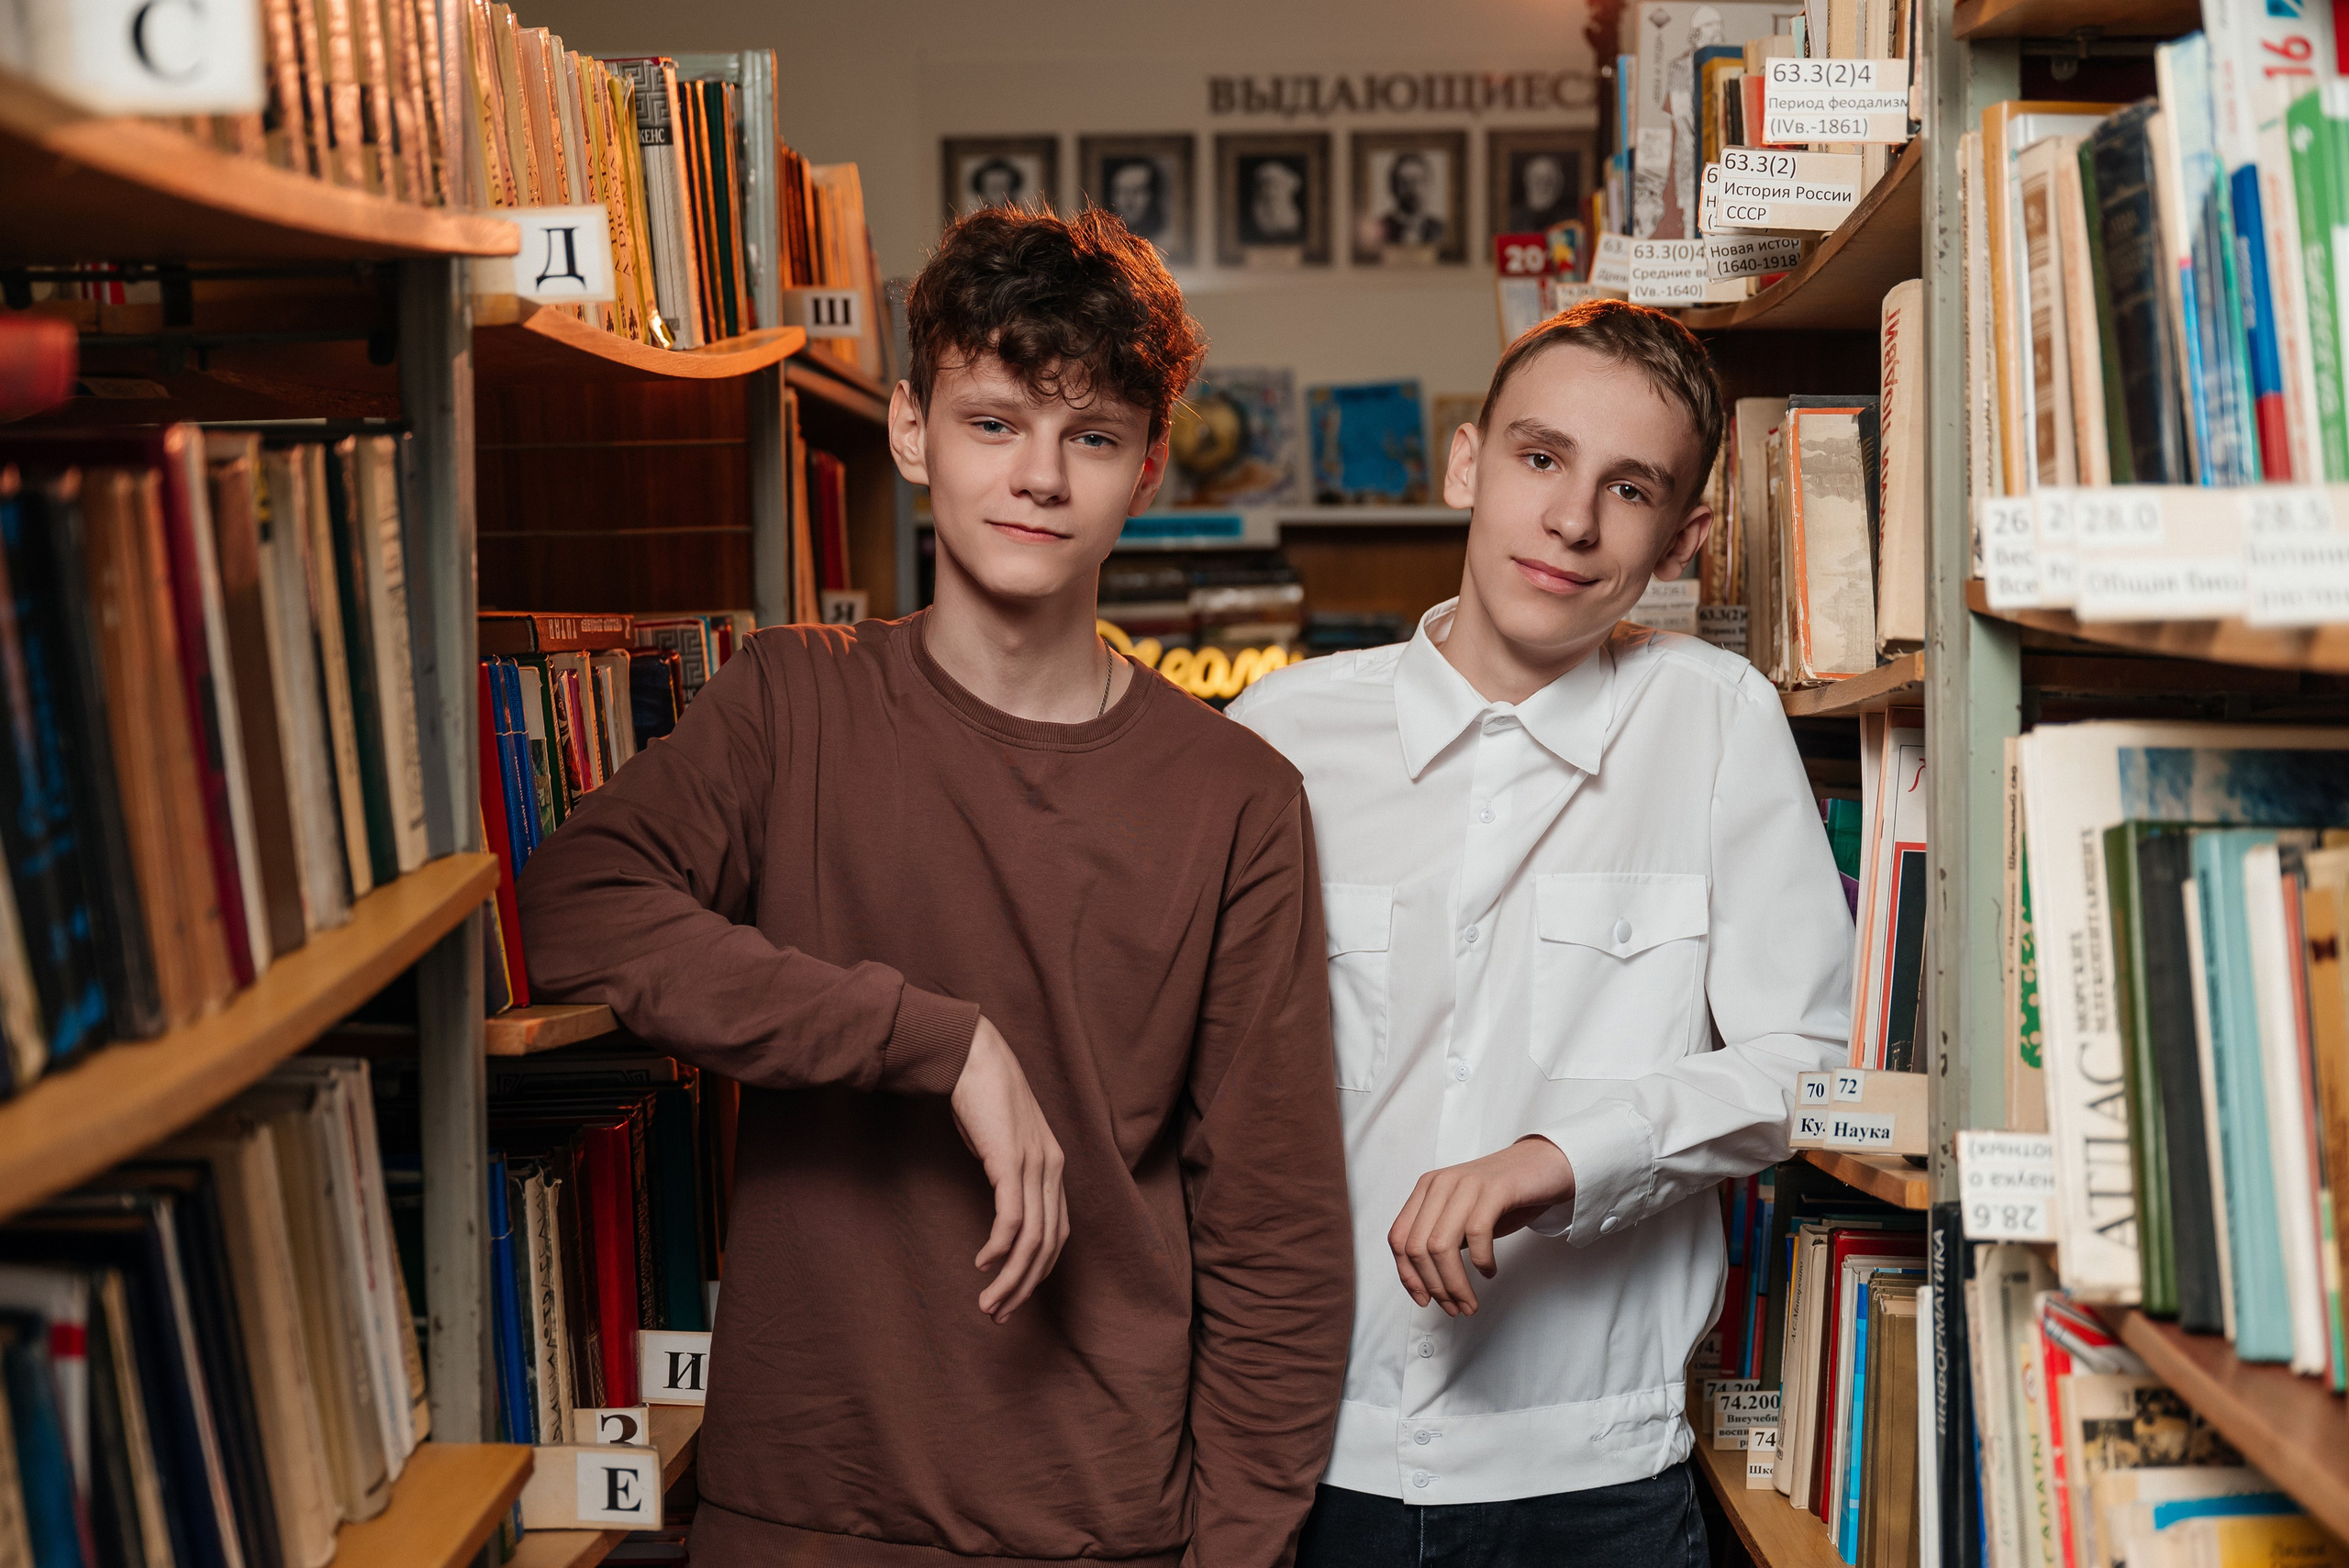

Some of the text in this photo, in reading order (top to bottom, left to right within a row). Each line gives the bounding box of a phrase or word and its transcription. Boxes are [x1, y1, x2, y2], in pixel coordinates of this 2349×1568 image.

[1773, 62, 1872, 87] 63.3(2)4
[1768, 97, 1824, 111] Период
[1770, 117, 1868, 137] (IVв.-1861)
[1724, 152, 1797, 179] 63.3(2)
[1723, 181, 1852, 203] История России
[1726, 206, 1766, 221] СССР
[536, 226, 586, 292] Д
[1710, 242, 1753, 258] Новая
[1632, 268, 1691, 281] Средние
[813, 297, 852, 326] Ш
[1882, 307, 1901, 438] ПОДВИГ
[1806, 1083, 1825, 1098] 70
[1839, 1078, 1857, 1095] 72
[1800, 1118, 1826, 1136] Ку
[1833, 1121, 1891, 1142] Наука
[1932, 1229, 1948, 1435] ИНФОРМАТИКА
[662, 1351, 707, 1391] И
[1720, 1394, 1779, 1410] 74.200
[601, 1466, 641, 1512] Е
